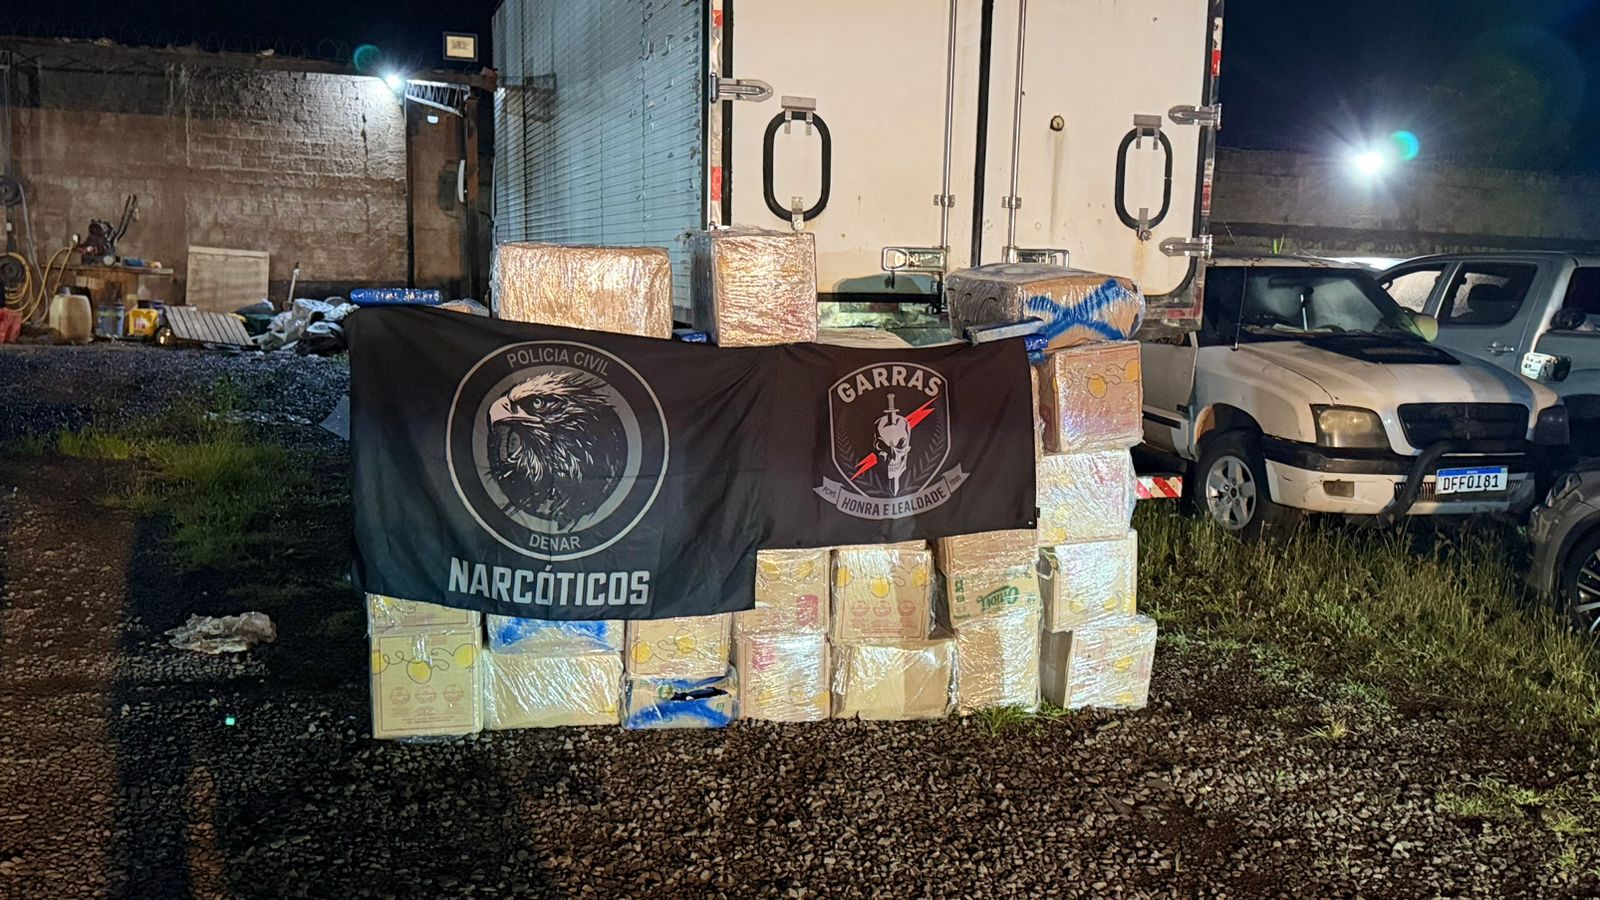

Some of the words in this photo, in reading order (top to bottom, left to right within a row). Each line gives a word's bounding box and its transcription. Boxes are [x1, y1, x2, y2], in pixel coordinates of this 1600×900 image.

[507, 348, 569, 368] POLICIA
[573, 352, 609, 376] CIVIL
[837, 366, 942, 403] GARRAS
[841, 497, 880, 516] HONRA
[883, 503, 890, 516] E
[892, 487, 947, 515] LEALDADE
[529, 534, 581, 551] DENAR
[448, 556, 650, 606] NARCÓTICOS
